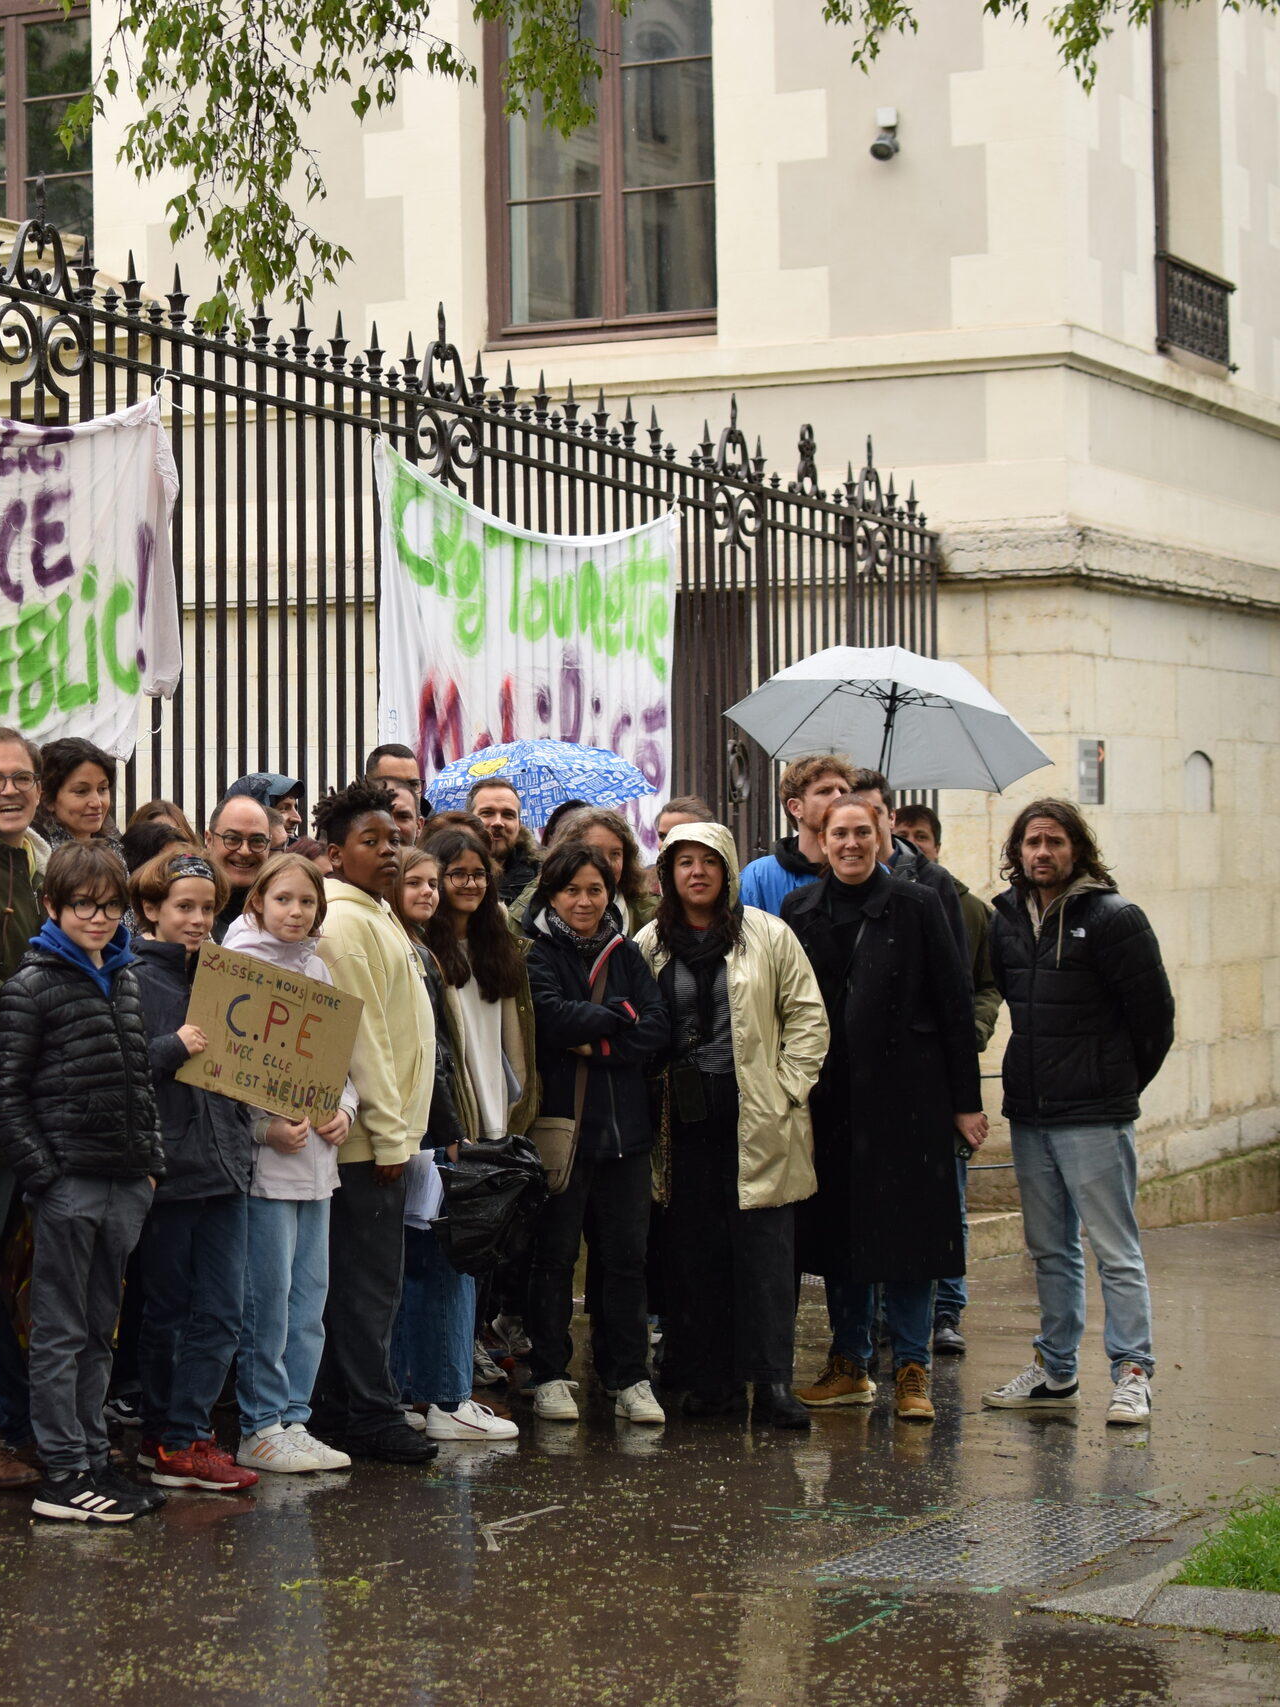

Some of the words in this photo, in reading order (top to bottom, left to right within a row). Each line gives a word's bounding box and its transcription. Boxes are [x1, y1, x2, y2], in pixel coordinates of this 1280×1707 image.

[225, 993, 323, 1059] C.P.E
[203, 1059, 222, 1078] ON
[226, 1040, 255, 1061] AVEC
[262, 1053, 293, 1074] ELLE
